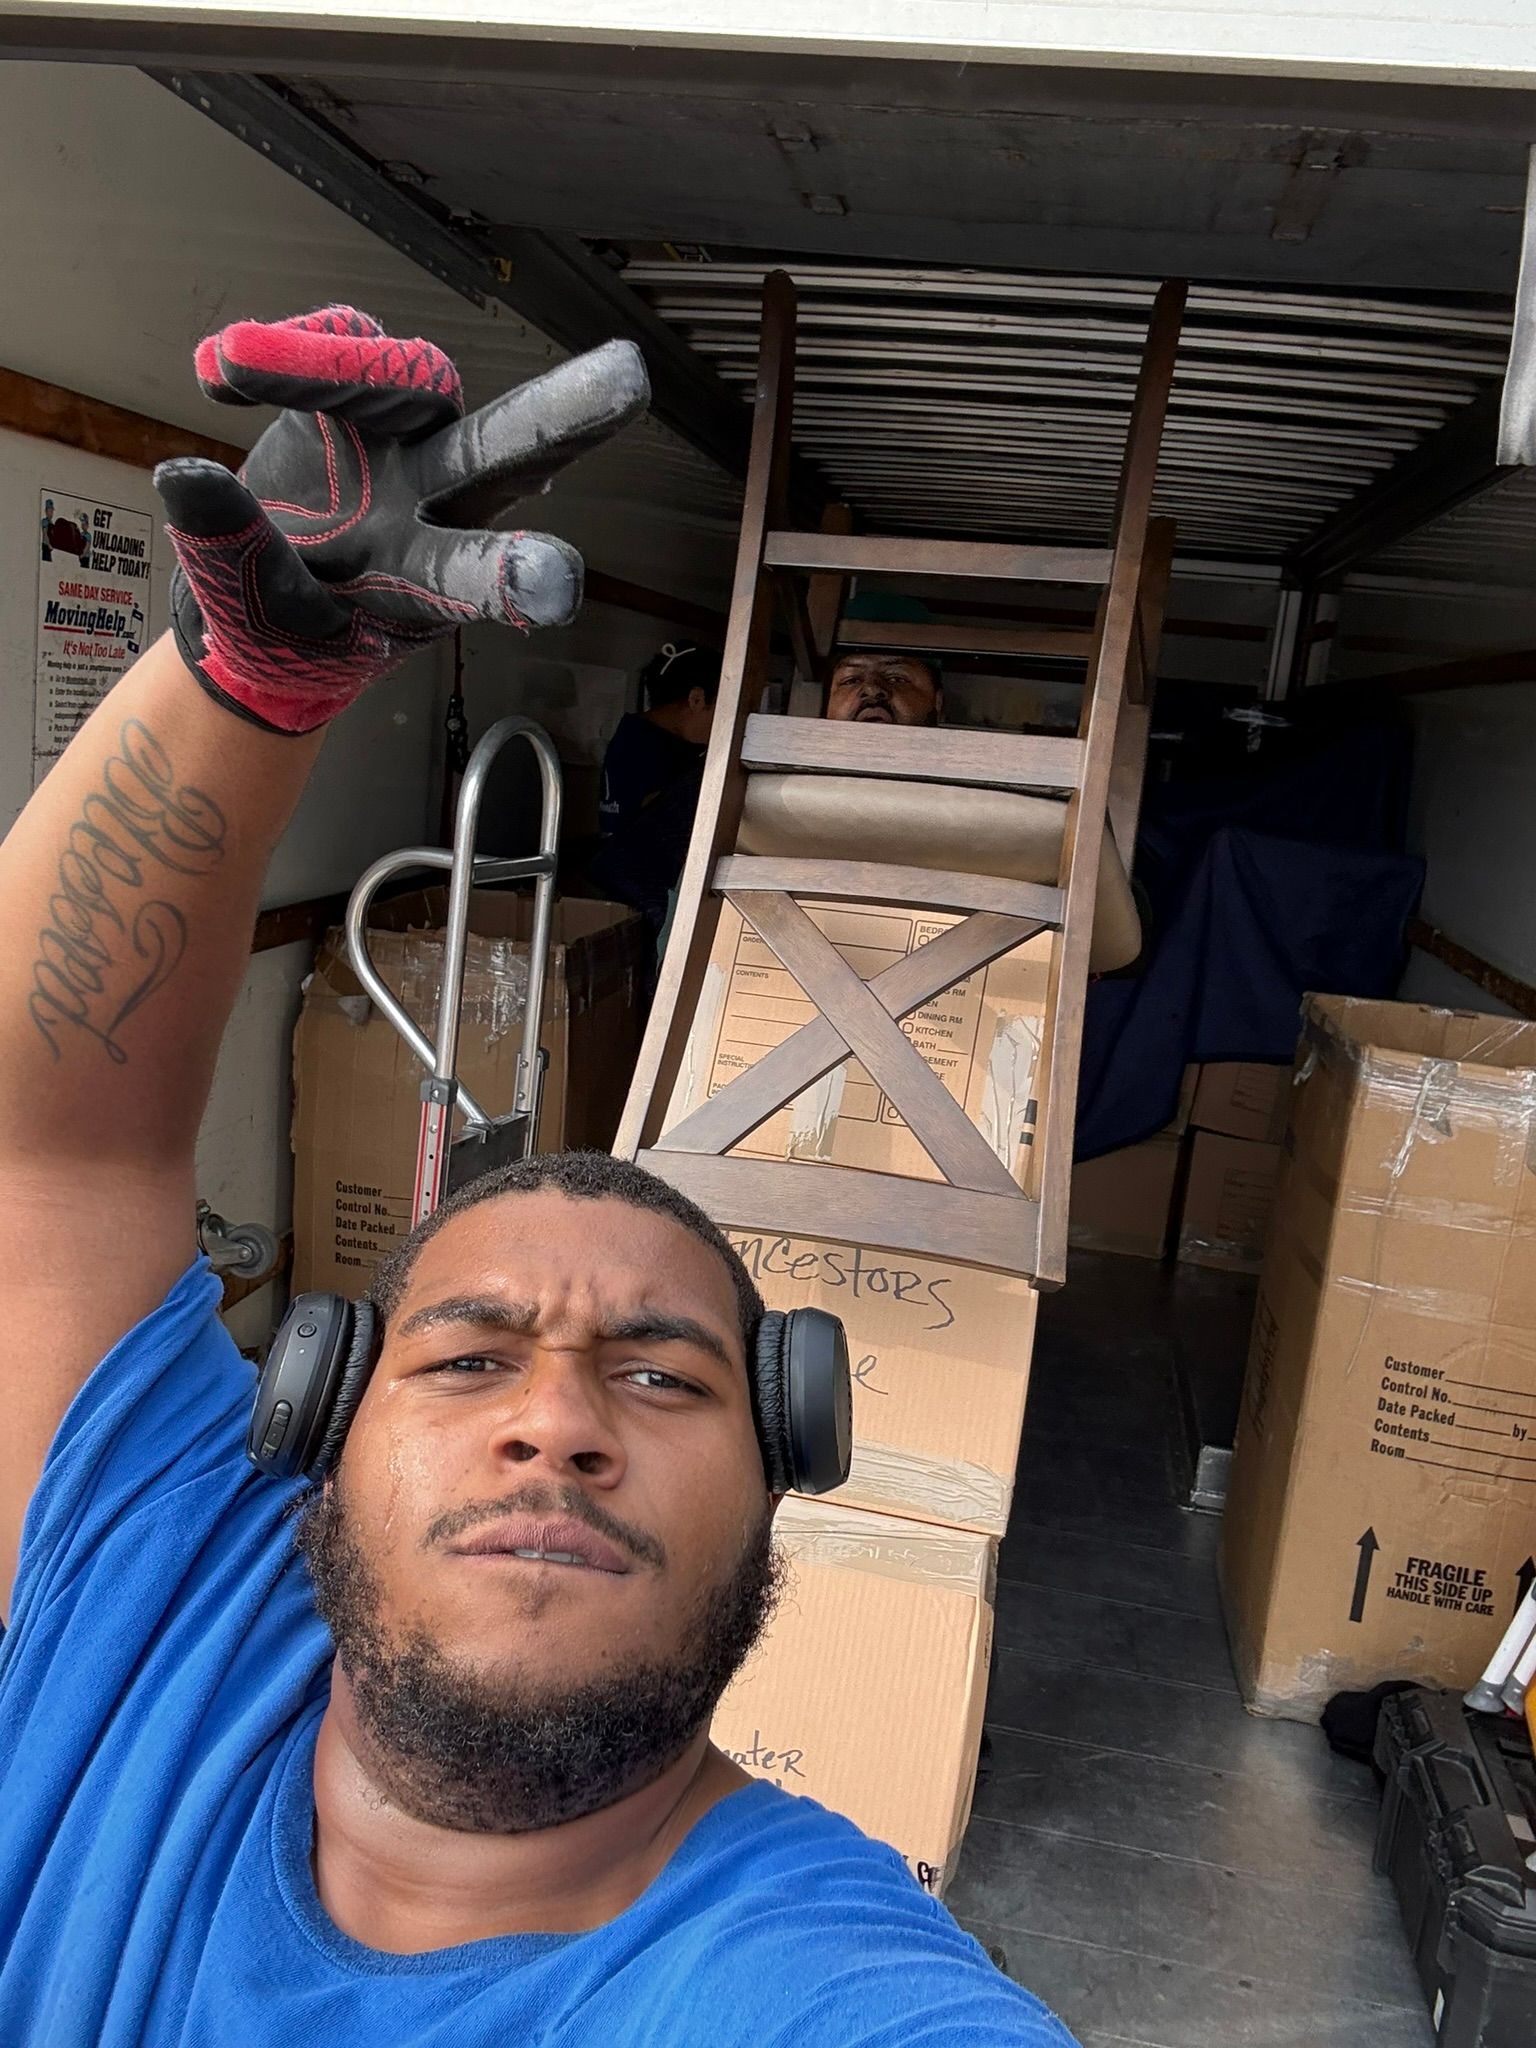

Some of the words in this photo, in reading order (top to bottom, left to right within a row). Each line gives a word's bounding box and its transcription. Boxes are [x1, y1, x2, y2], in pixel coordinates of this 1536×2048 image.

[93, 508, 113, 530] GET
[92, 530, 145, 558] UNLOADING
[91, 551, 117, 573] HELP
[117, 557, 151, 580] TODAY!
[58, 581, 83, 599] SAME
[84, 584, 100, 601] DAY
[100, 587, 133, 606] SERVICE
[63, 639, 79, 656] It's
[79, 641, 94, 658] Not
[94, 643, 108, 658] Too
[108, 644, 126, 660] Late
[919, 925, 951, 935] BEDR
[736, 969, 769, 979] CONTENTS
[951, 988, 967, 998] RM
[917, 1011, 948, 1024] DINING
[948, 1015, 963, 1025] RM
[914, 1026, 954, 1039] KITCHEN
[913, 1039, 937, 1050] BATH
[718, 1052, 745, 1062] SPECIAL
[336, 1180, 383, 1198] Customer
[336, 1198, 372, 1215] Control
[374, 1204, 391, 1217] No.
[336, 1216, 357, 1230] Date
[360, 1219, 396, 1236] Packed
[335, 1234, 379, 1252] Contents
[335, 1252, 362, 1267] Room
[1384, 1355, 1446, 1381] Customer
[1381, 1376, 1428, 1399] Control
[1431, 1387, 1452, 1404] No.
[1377, 1397, 1407, 1416] Date
[1410, 1404, 1456, 1426] Packed
[1512, 1423, 1528, 1442] by
[1374, 1418, 1431, 1443] Contents
[1370, 1438, 1406, 1459] Room
[1406, 1556, 1487, 1587] FRAGILE
[1395, 1572, 1429, 1593] THIS
[1433, 1580, 1469, 1600] SIDE
[1471, 1587, 1494, 1603] UP
[1386, 1586, 1432, 1606] HANDLE
[1434, 1595, 1463, 1612] WITH
[1465, 1601, 1496, 1617] CARE
